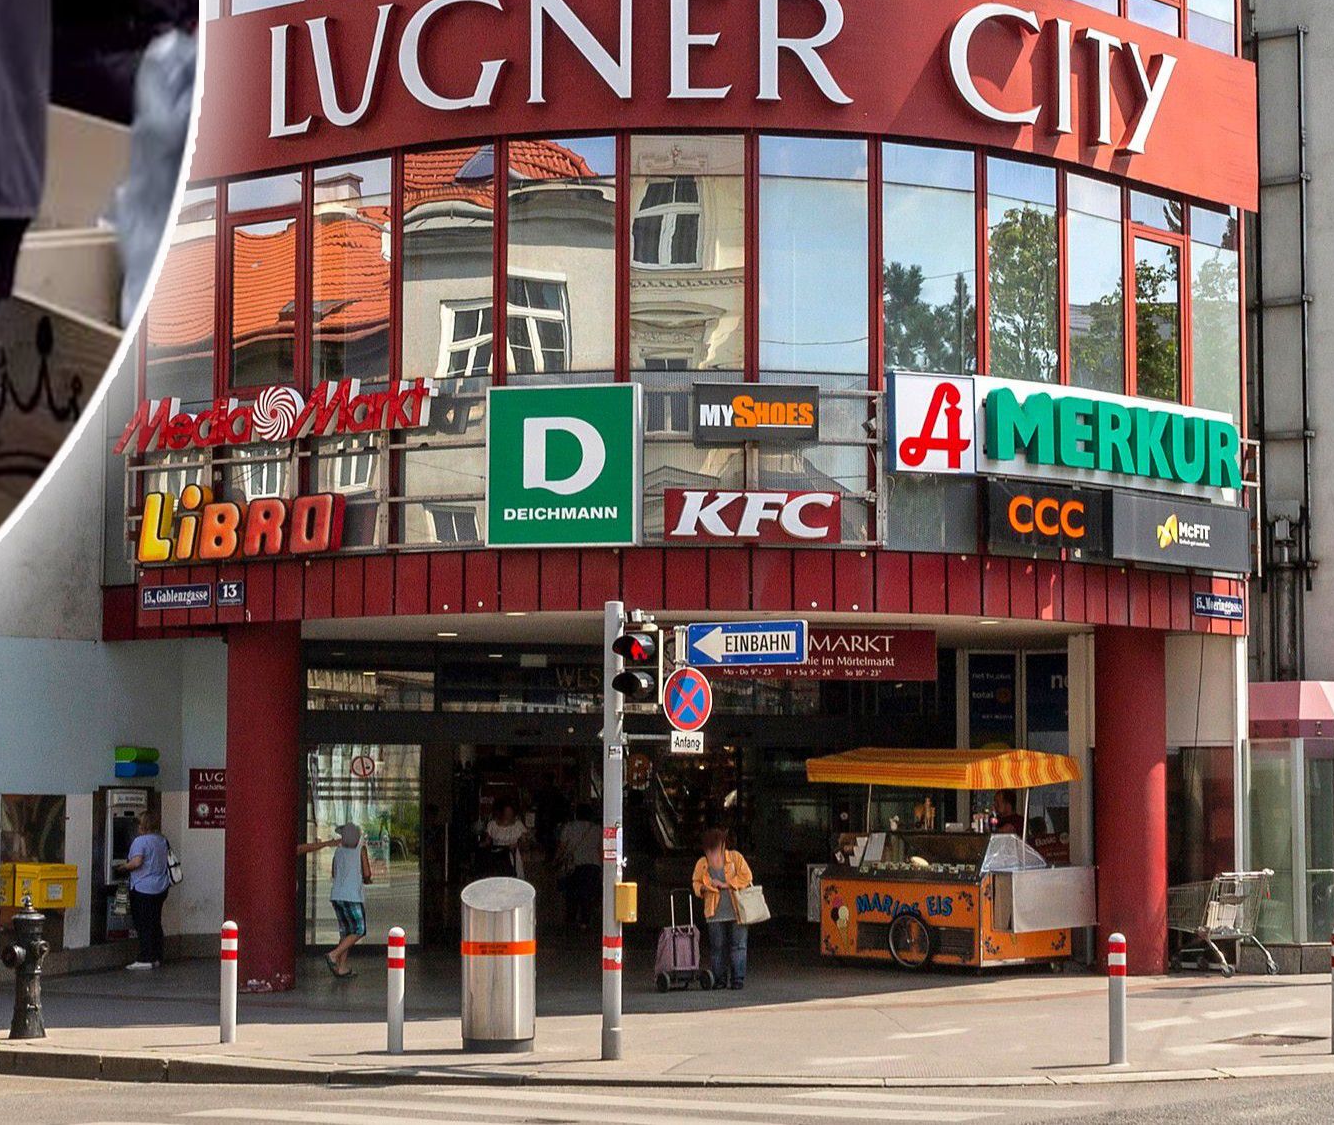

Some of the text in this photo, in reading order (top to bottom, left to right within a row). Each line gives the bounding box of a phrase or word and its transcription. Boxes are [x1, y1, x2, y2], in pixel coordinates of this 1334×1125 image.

[947, 2, 1178, 156] CITY
[113, 377, 439, 455] Media Markt
[986, 387, 1243, 490] MERKUR
[522, 416, 607, 496] D
[504, 506, 618, 522] DEICHMANN
[670, 491, 836, 539] KFC
[1008, 495, 1085, 538] CCC
[1178, 521, 1211, 541] McFIT
[156, 589, 208, 605] Gablenzgasse
[222, 584, 238, 598] 13
[725, 633, 791, 653] EINBAHN
[809, 635, 895, 653] MARKT
[822, 656, 834, 666] im
[837, 656, 895, 666] Mörtelmarkt
[673, 735, 701, 751] Anfang
[927, 895, 953, 917] EIS
